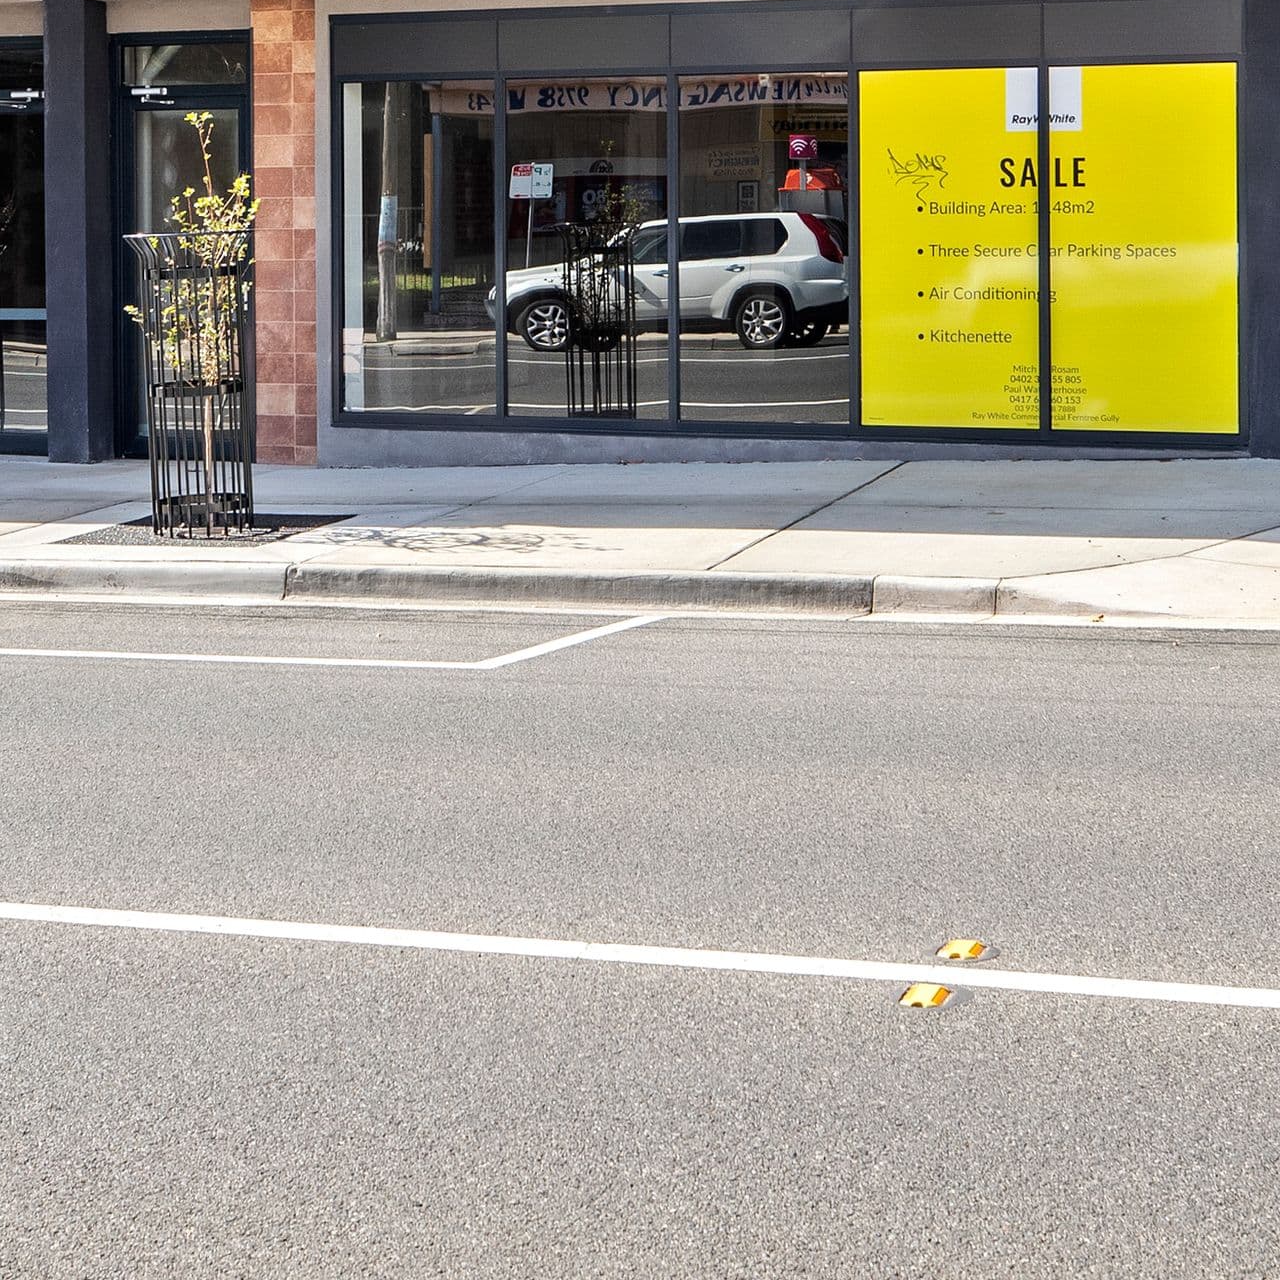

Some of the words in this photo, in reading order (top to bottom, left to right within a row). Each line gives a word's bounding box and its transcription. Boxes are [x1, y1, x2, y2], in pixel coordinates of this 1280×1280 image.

[1000, 157, 1086, 188] SALE
[928, 201, 986, 217] Building
[989, 201, 1026, 214] Area:
[928, 244, 969, 258] Three
[973, 244, 1021, 258] Secure
[1068, 244, 1122, 260] Parking
[1126, 244, 1177, 260] Spaces
[928, 287, 949, 301] Air
[930, 329, 1012, 344] Kitchenette
[1013, 365, 1037, 373] Mitch
[1051, 366, 1079, 374] Rosam
[1010, 375, 1032, 383] 0402
[1065, 375, 1082, 384] 805
[1003, 385, 1022, 393] Paul
[1009, 395, 1031, 404] 0417
[1065, 396, 1081, 404] 153
[972, 412, 985, 420] Ray
[987, 412, 1010, 420] White
